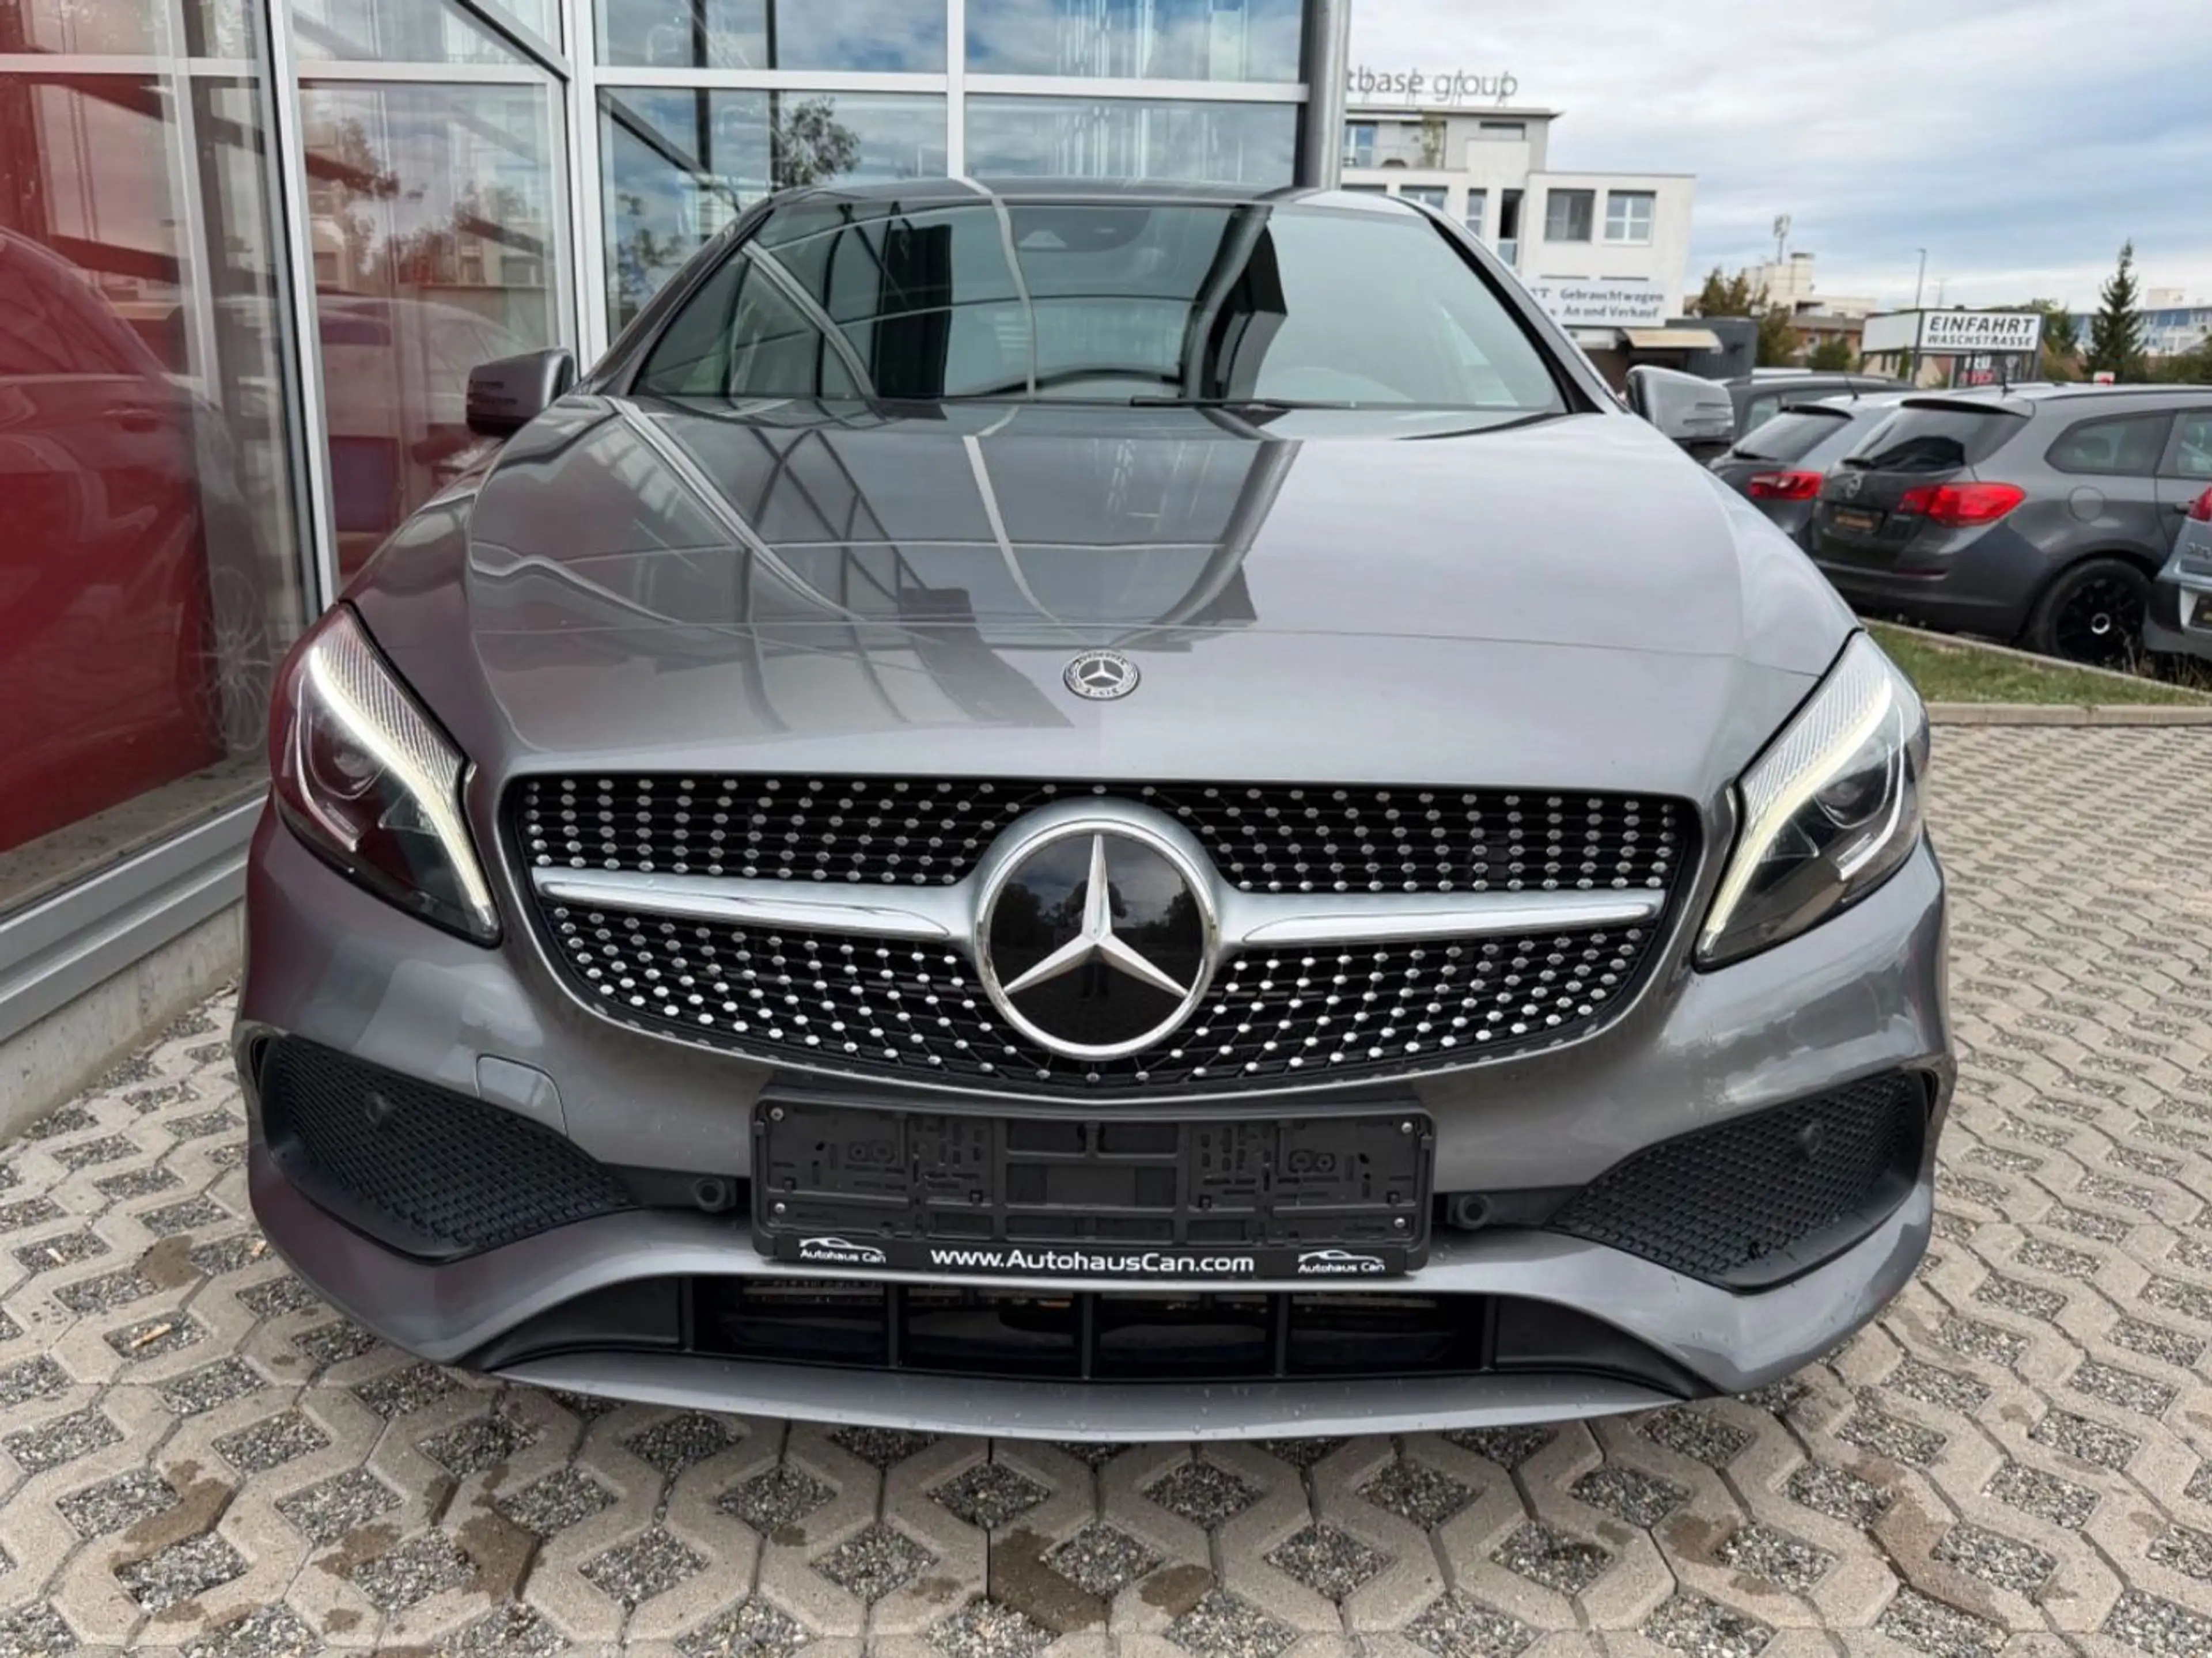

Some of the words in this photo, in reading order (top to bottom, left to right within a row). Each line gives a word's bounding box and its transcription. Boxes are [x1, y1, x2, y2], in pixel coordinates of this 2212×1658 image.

[1433, 73, 1518, 102] group
[1584, 306, 1606, 317] und
[1609, 306, 1659, 318] Verkauf
[1930, 316, 2036, 335] EINFAHRT
[1927, 334, 2033, 347] WASCHSTRASSE
[800, 1249, 859, 1262] Autohaus
[862, 1251, 887, 1264] Can
[930, 1249, 1255, 1272] www.AutohausCan.com
[1298, 1262, 1358, 1274] Autohaus
[1360, 1261, 1385, 1273] Can
